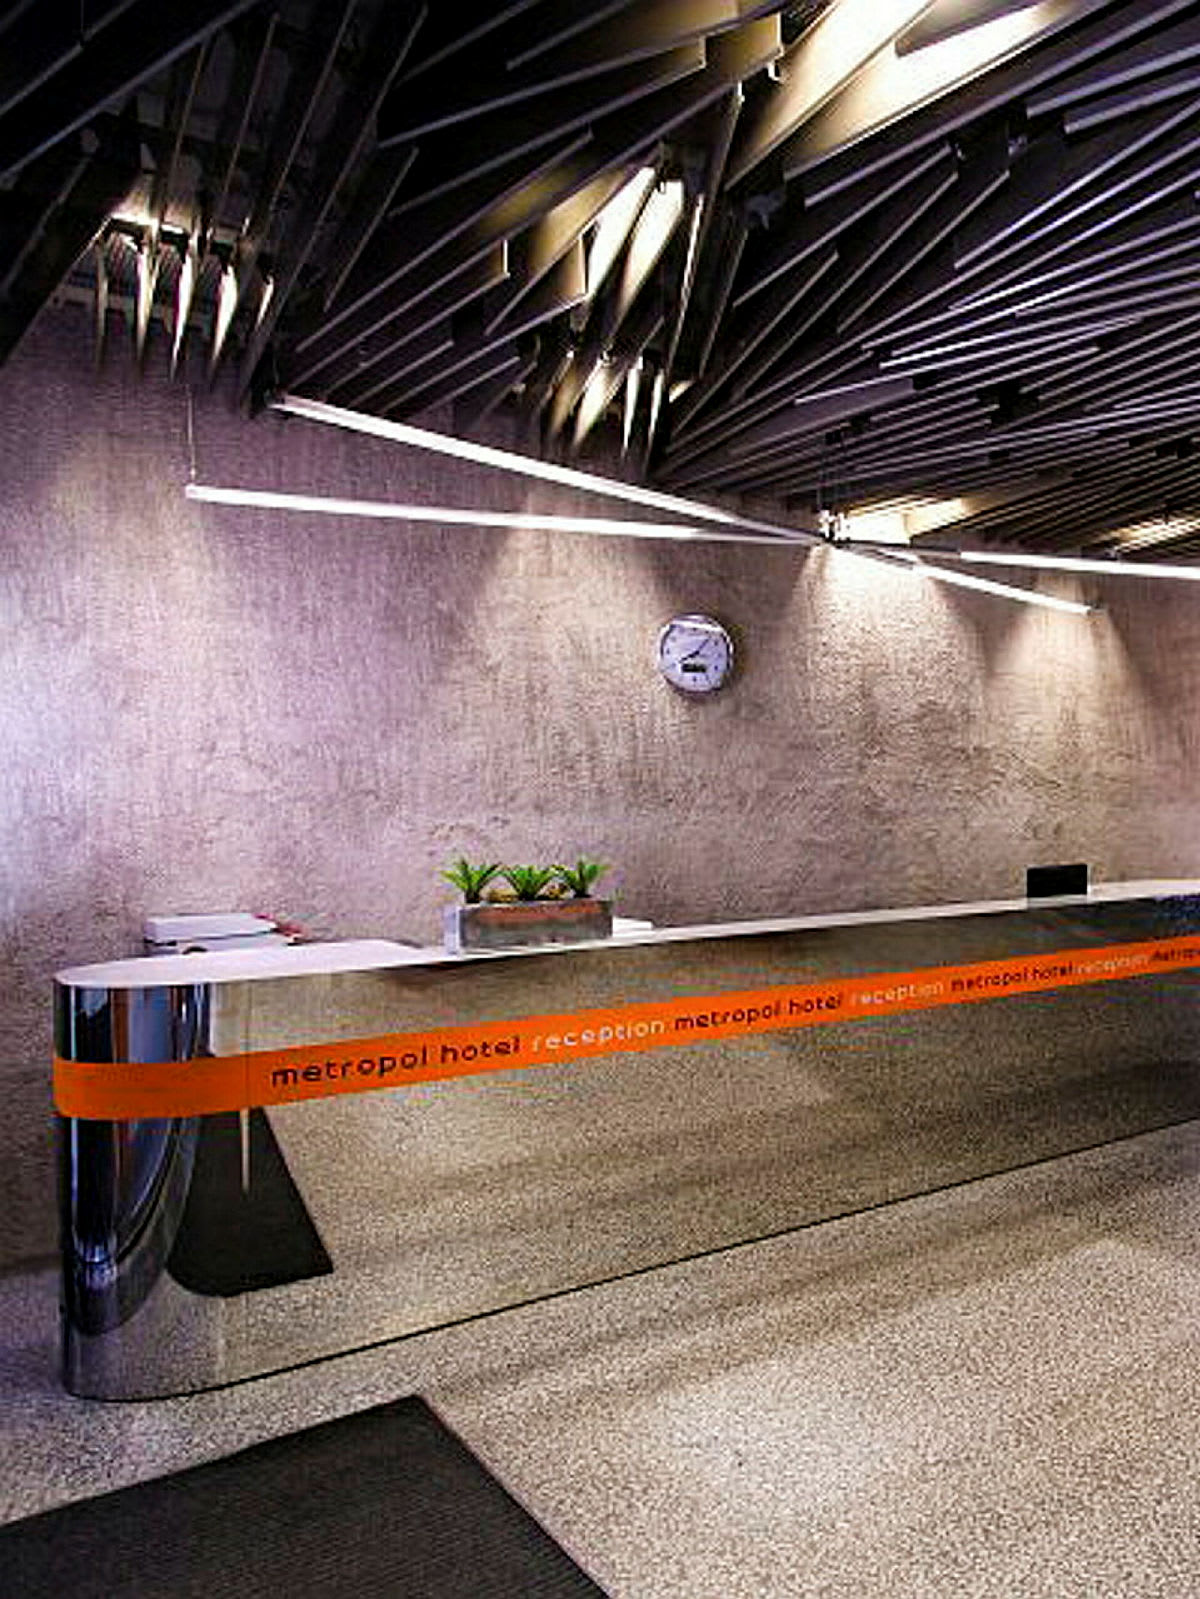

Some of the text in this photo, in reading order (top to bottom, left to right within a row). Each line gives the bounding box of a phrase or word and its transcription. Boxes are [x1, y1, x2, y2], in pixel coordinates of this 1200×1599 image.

[271, 1045, 428, 1087] metropol
[440, 1036, 521, 1064] hotel
[531, 1017, 665, 1052] reception
[673, 1001, 781, 1032] metropol
[788, 992, 843, 1016] hotel
[851, 980, 945, 1006] reception
[951, 967, 1028, 993] metropol
[1031, 961, 1073, 981] hotel
